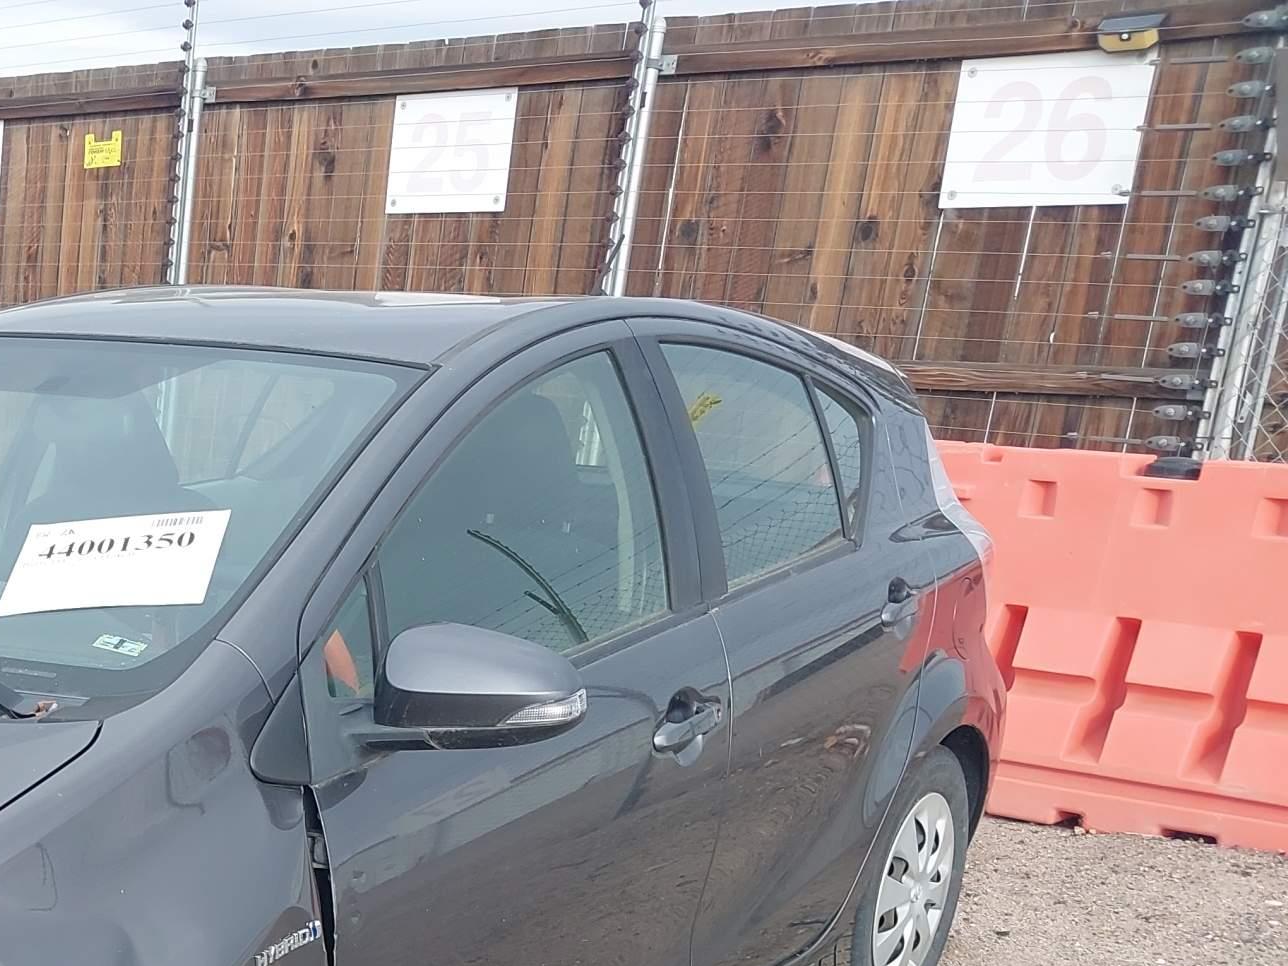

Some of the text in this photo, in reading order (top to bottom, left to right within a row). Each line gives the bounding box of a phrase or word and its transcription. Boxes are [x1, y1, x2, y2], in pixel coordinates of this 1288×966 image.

[406, 111, 493, 193] 25
[971, 75, 1114, 183] 26
[38, 531, 196, 559] 44001350
